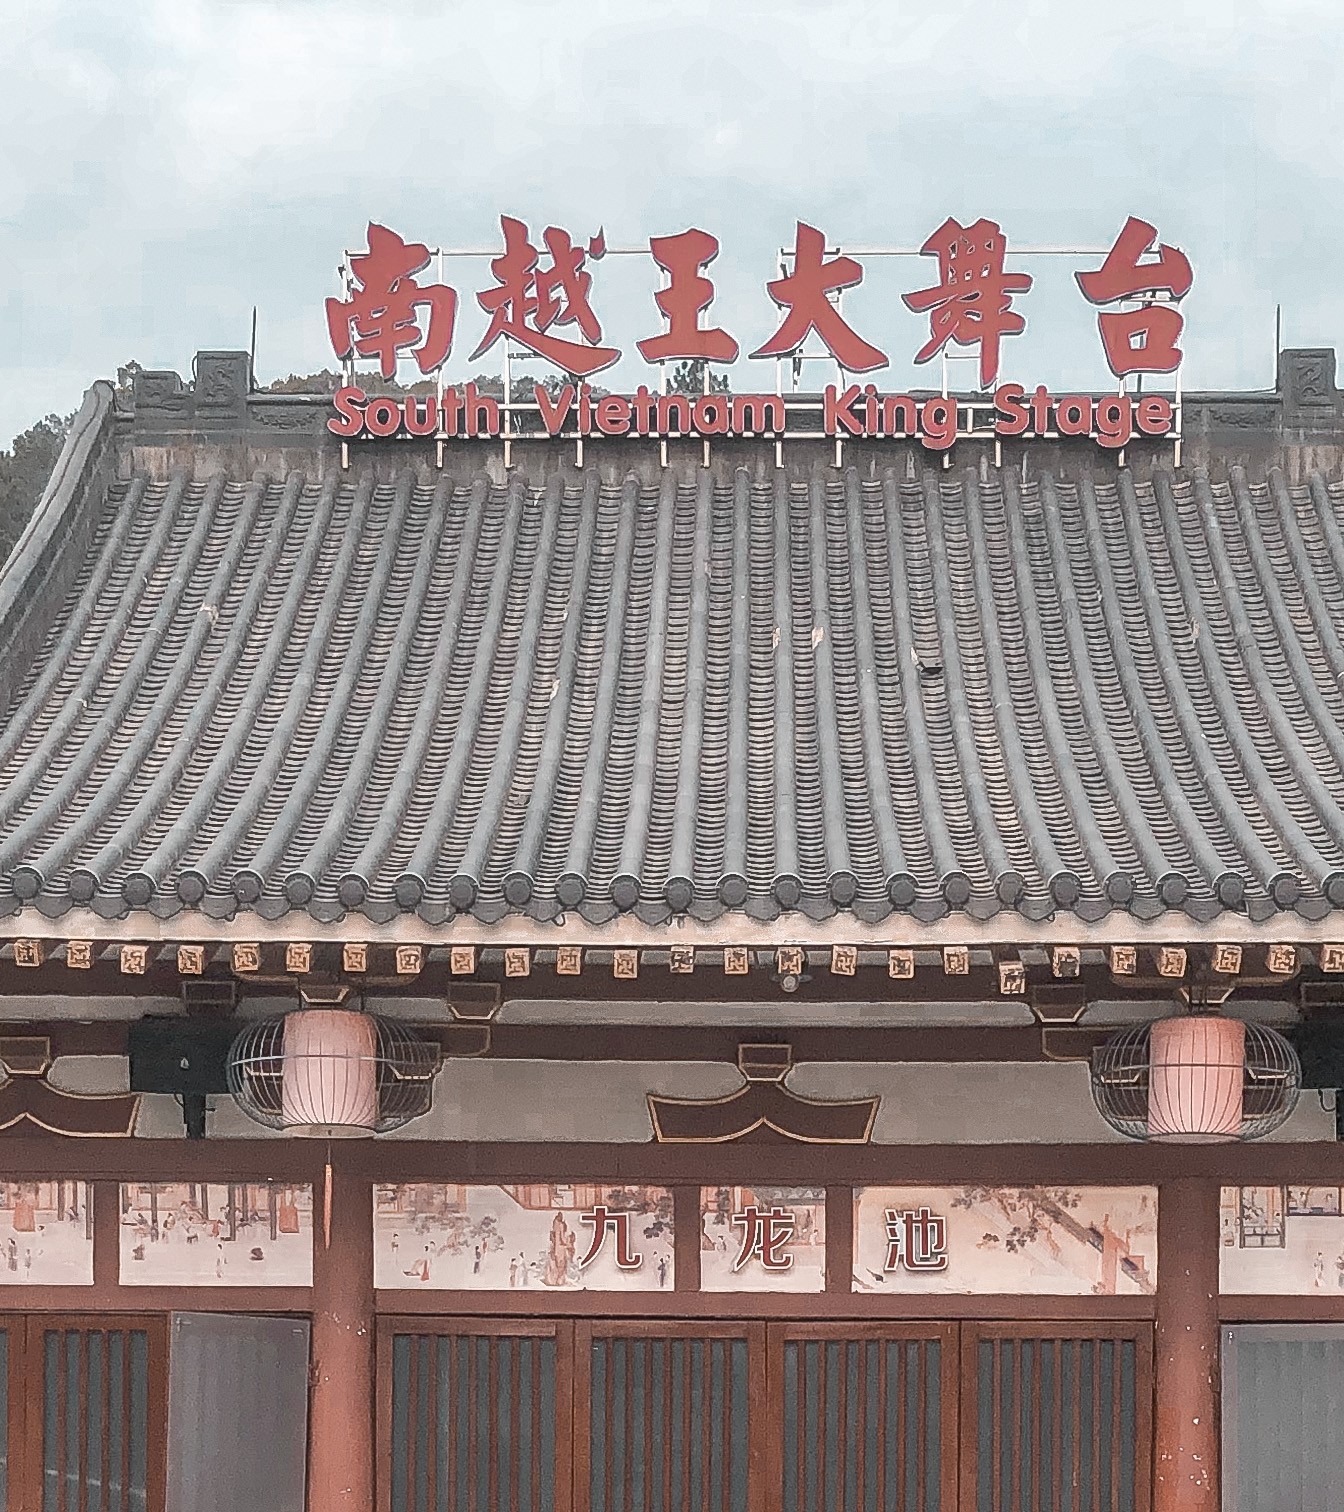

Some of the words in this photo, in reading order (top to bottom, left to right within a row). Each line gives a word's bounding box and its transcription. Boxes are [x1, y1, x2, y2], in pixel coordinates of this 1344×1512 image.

[327, 215, 1194, 389] 南越王大舞台
[327, 385, 500, 437] South
[535, 384, 785, 437] Vietnam
[824, 384, 956, 449] King
[992, 384, 1174, 449] Stage
[579, 1205, 948, 1273] 九龙池
